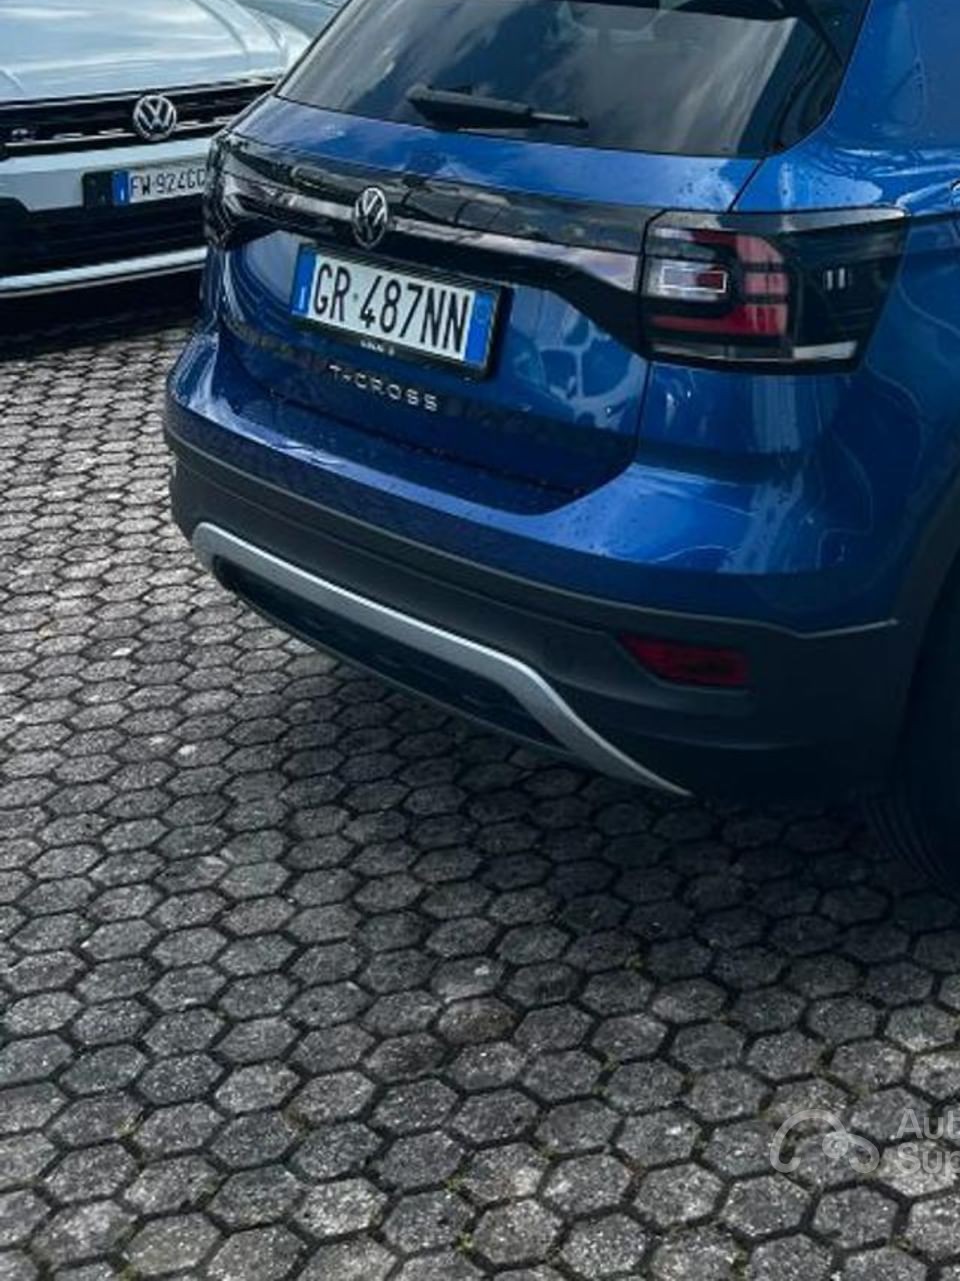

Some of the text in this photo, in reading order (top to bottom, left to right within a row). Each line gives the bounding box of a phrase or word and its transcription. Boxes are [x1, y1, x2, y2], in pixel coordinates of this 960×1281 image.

[313, 263, 470, 354] GR 487NN
[329, 364, 438, 412] T-CROSS
